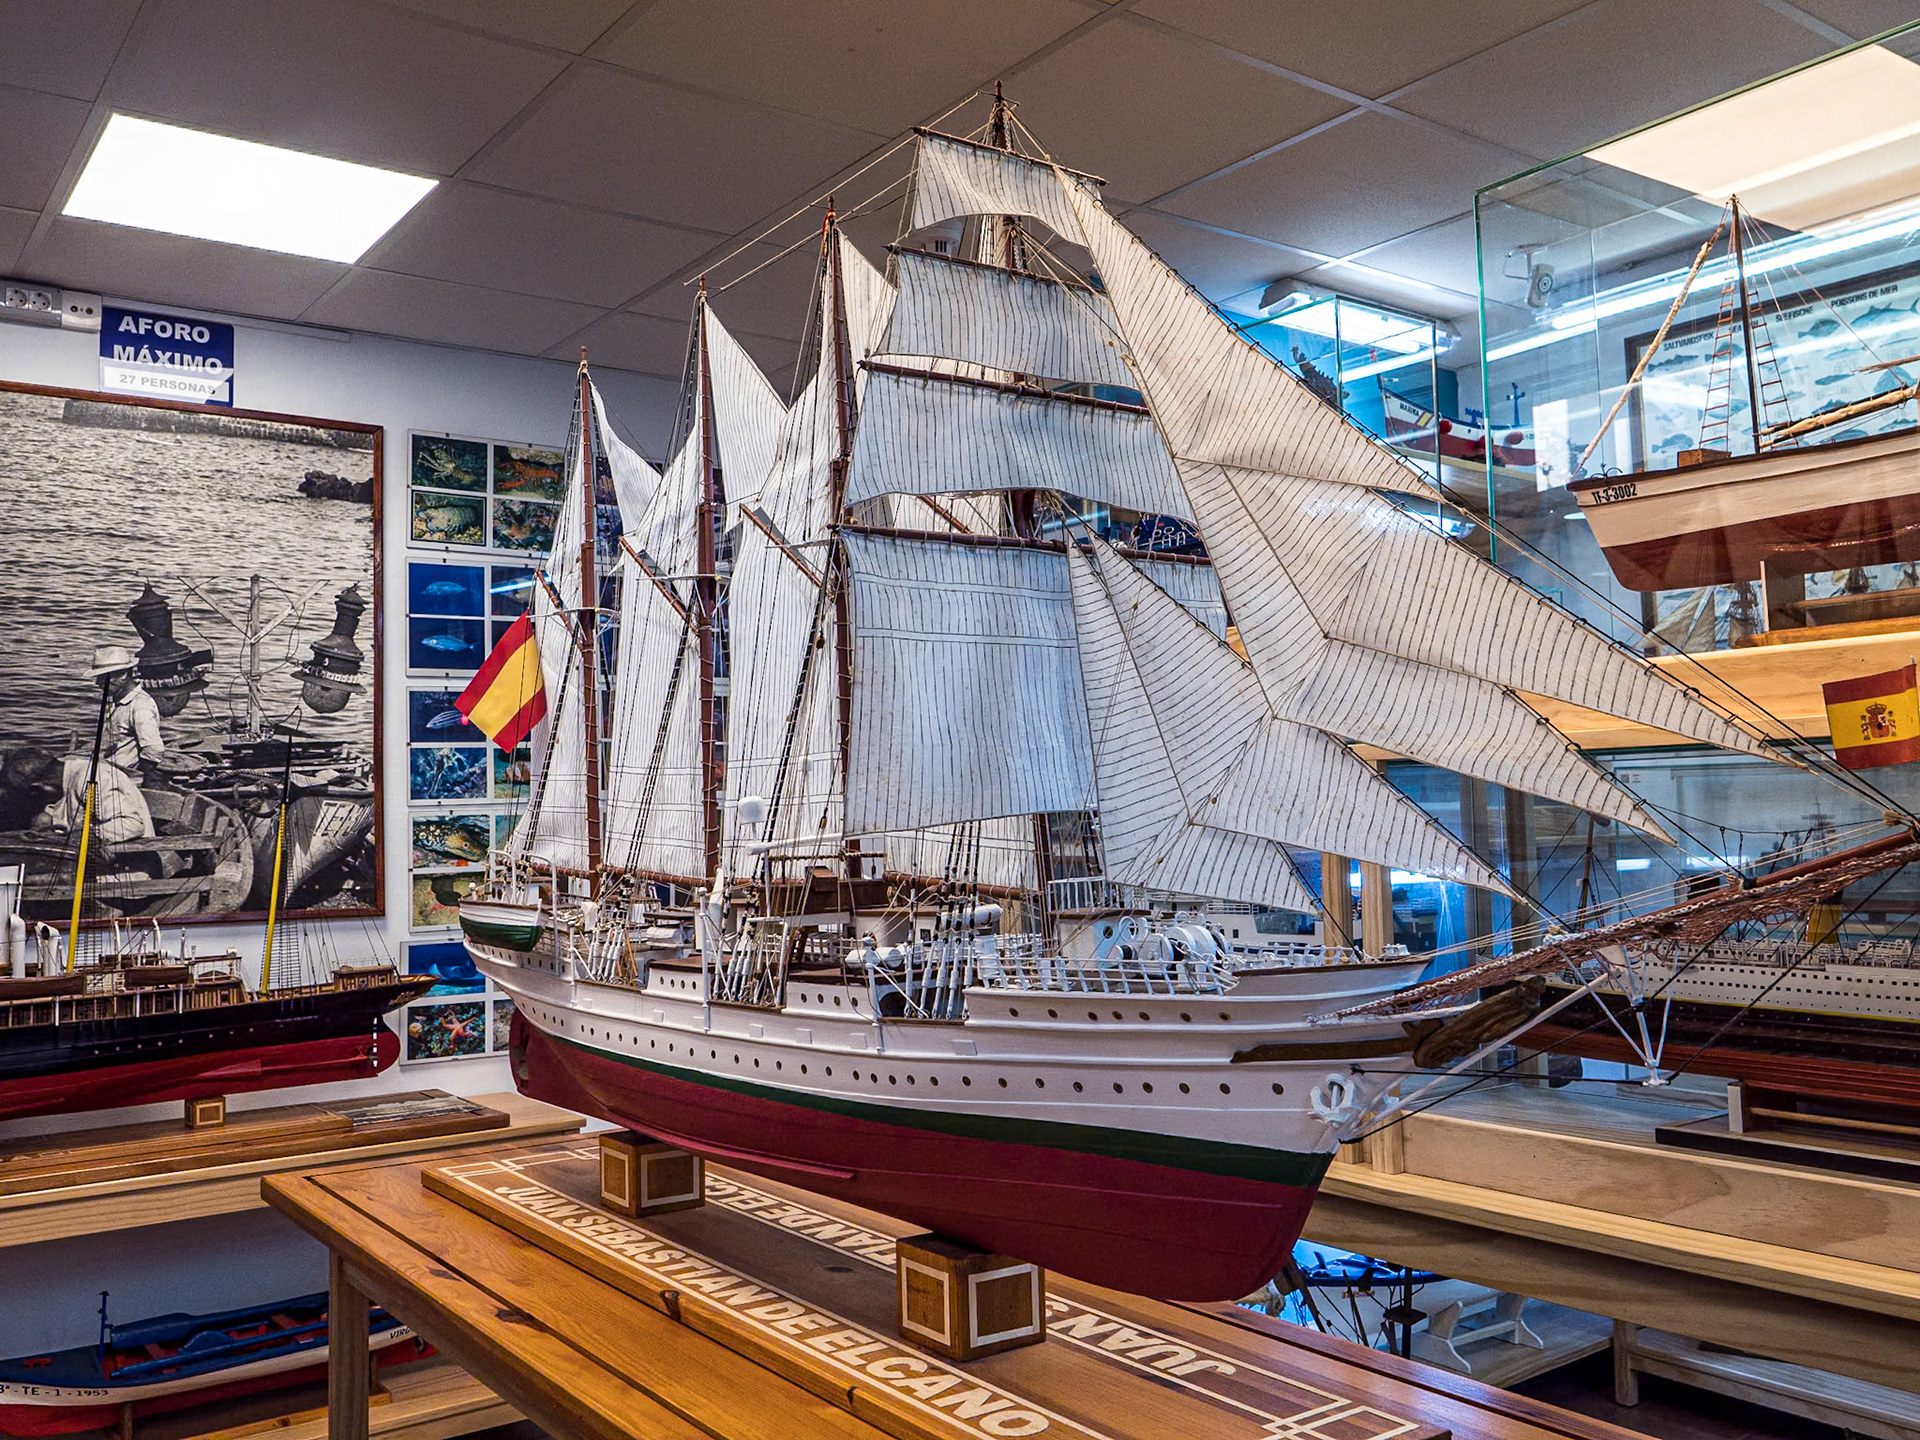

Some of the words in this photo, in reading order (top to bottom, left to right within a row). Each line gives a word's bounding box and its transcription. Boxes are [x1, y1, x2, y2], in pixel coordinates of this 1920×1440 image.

[1831, 292, 1867, 307] POISSONS
[1868, 289, 1879, 299] DE
[1880, 285, 1898, 296] MER
[118, 315, 211, 343] AFORO
[113, 344, 223, 375] MÁXIMO
[119, 374, 136, 385] 27
[141, 376, 216, 395] PERSONAS
[1591, 483, 1638, 504] TF-3-3002
[753, 1205, 830, 1228] DE
[495, 1186, 590, 1219] JUAN
[562, 1215, 780, 1306] SEBASTIAN
[744, 1300, 840, 1336] DE
[804, 1329, 1050, 1437] ELCANO
[1047, 1313, 1236, 1377] JUAN
